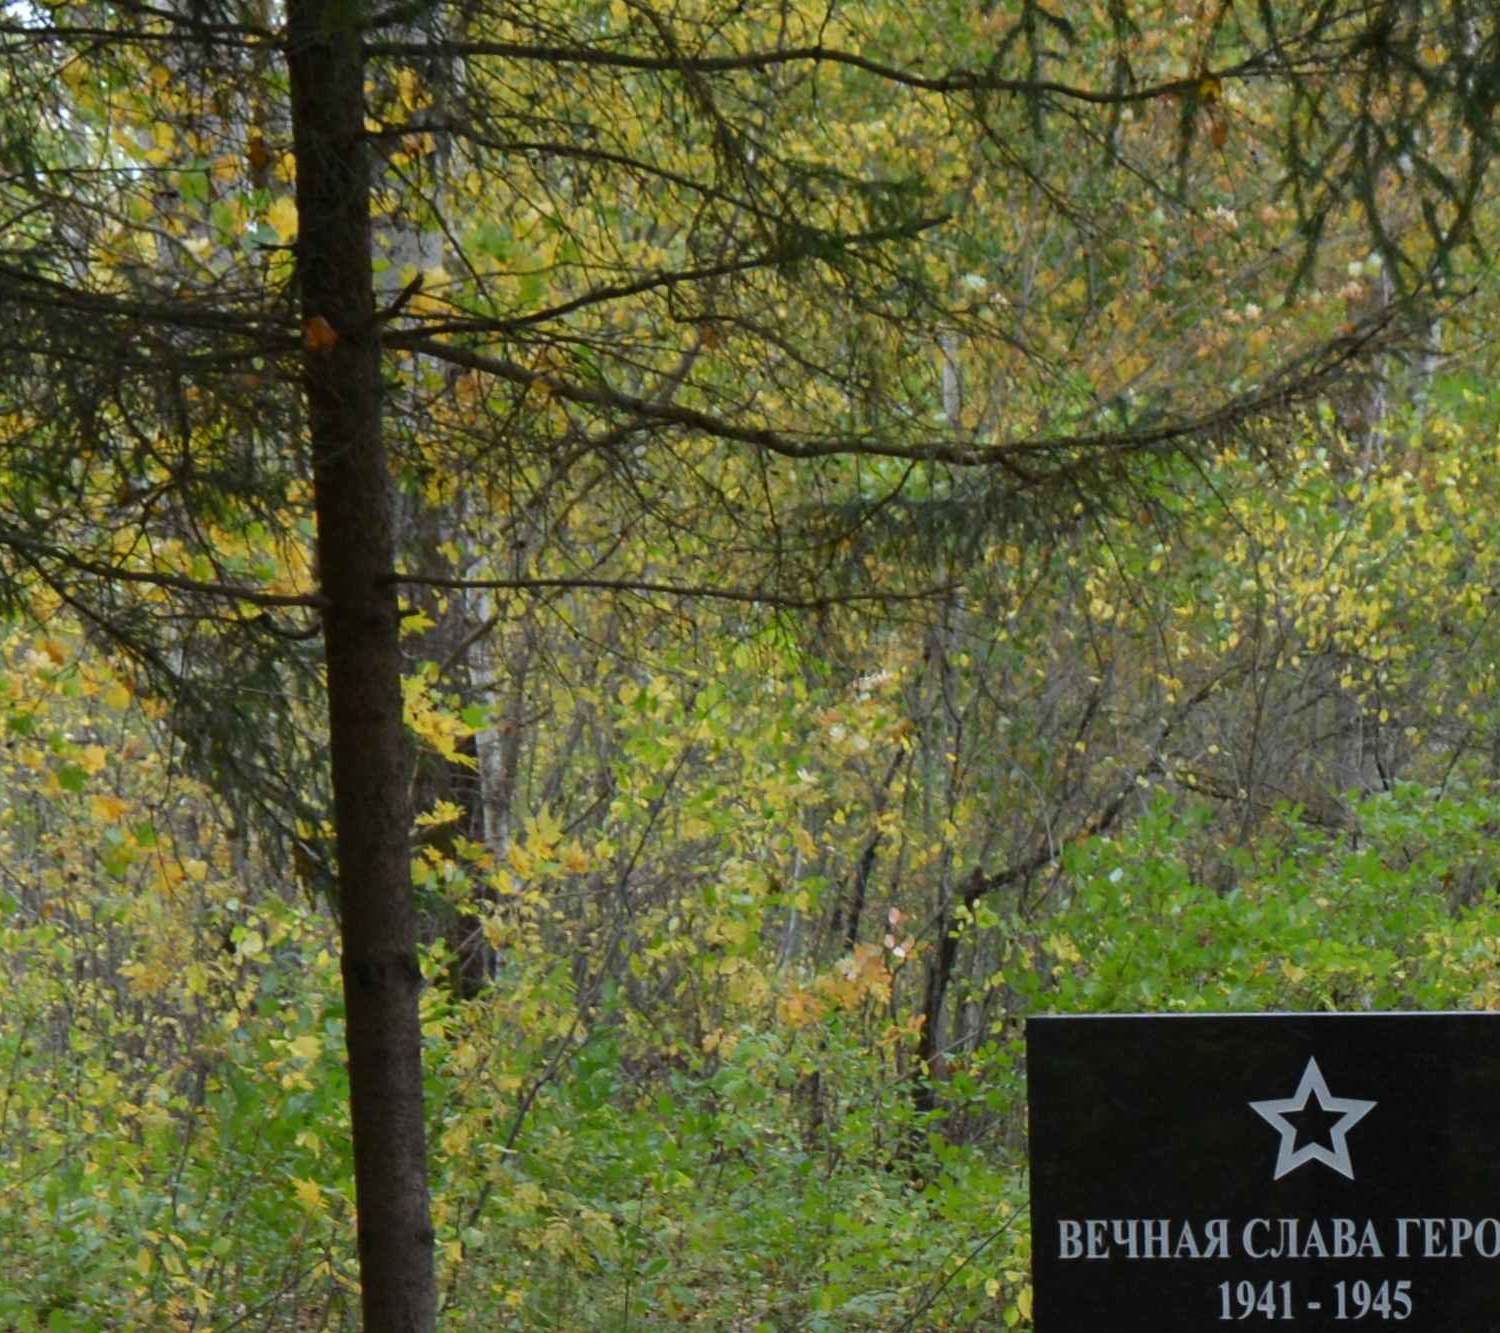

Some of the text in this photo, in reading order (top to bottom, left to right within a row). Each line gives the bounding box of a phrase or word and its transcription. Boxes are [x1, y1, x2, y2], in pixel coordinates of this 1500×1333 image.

[1058, 1219, 1230, 1258] ВЕЧНАЯ
[1243, 1218, 1384, 1258] СЛАВА
[1219, 1280, 1294, 1319] 1941
[1335, 1280, 1412, 1319] 1945
